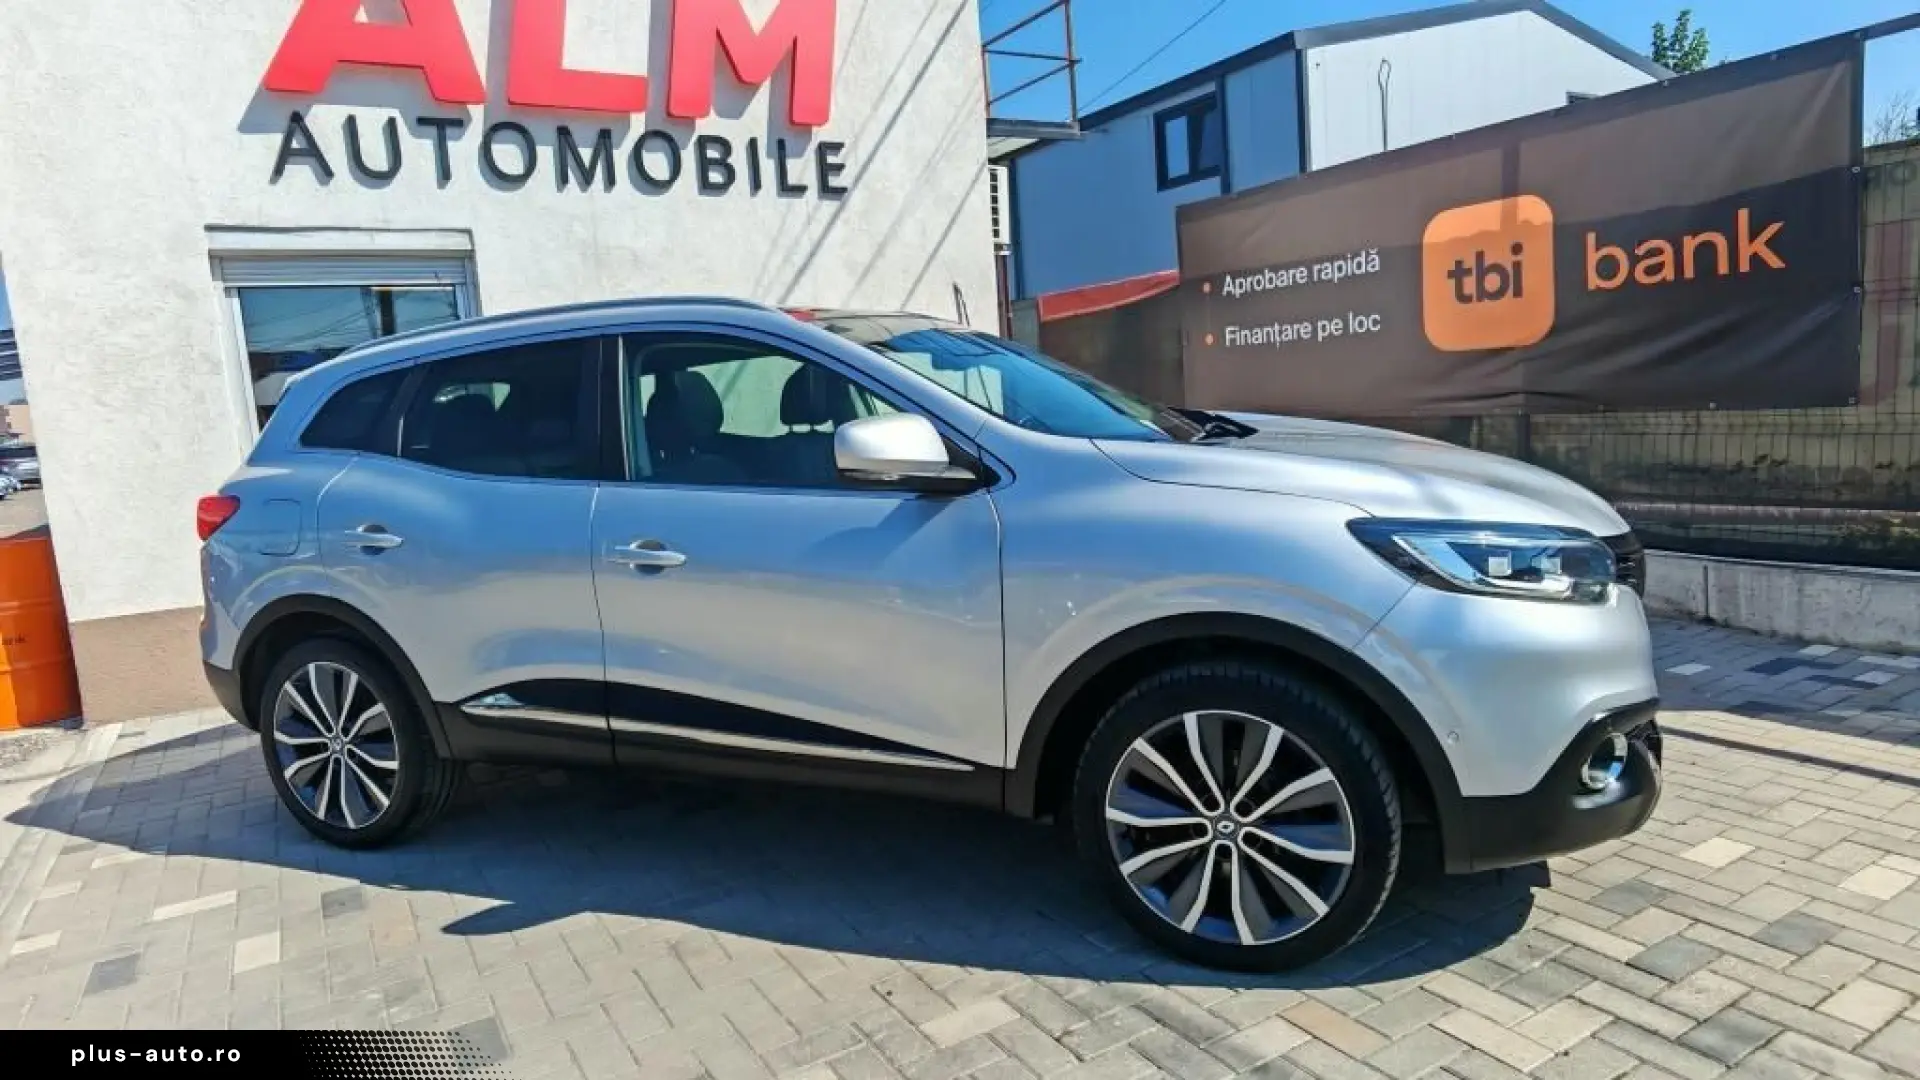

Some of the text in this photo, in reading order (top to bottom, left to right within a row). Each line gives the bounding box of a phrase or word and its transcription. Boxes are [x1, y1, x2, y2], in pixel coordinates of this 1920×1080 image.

[264, 0, 836, 126] ALM
[270, 110, 849, 199] AUTOMOBILE
[1221, 248, 1381, 299] Aprobare rapidă
[1447, 207, 1786, 304] tbi bank
[1224, 310, 1381, 351] Finanțare pe loc
